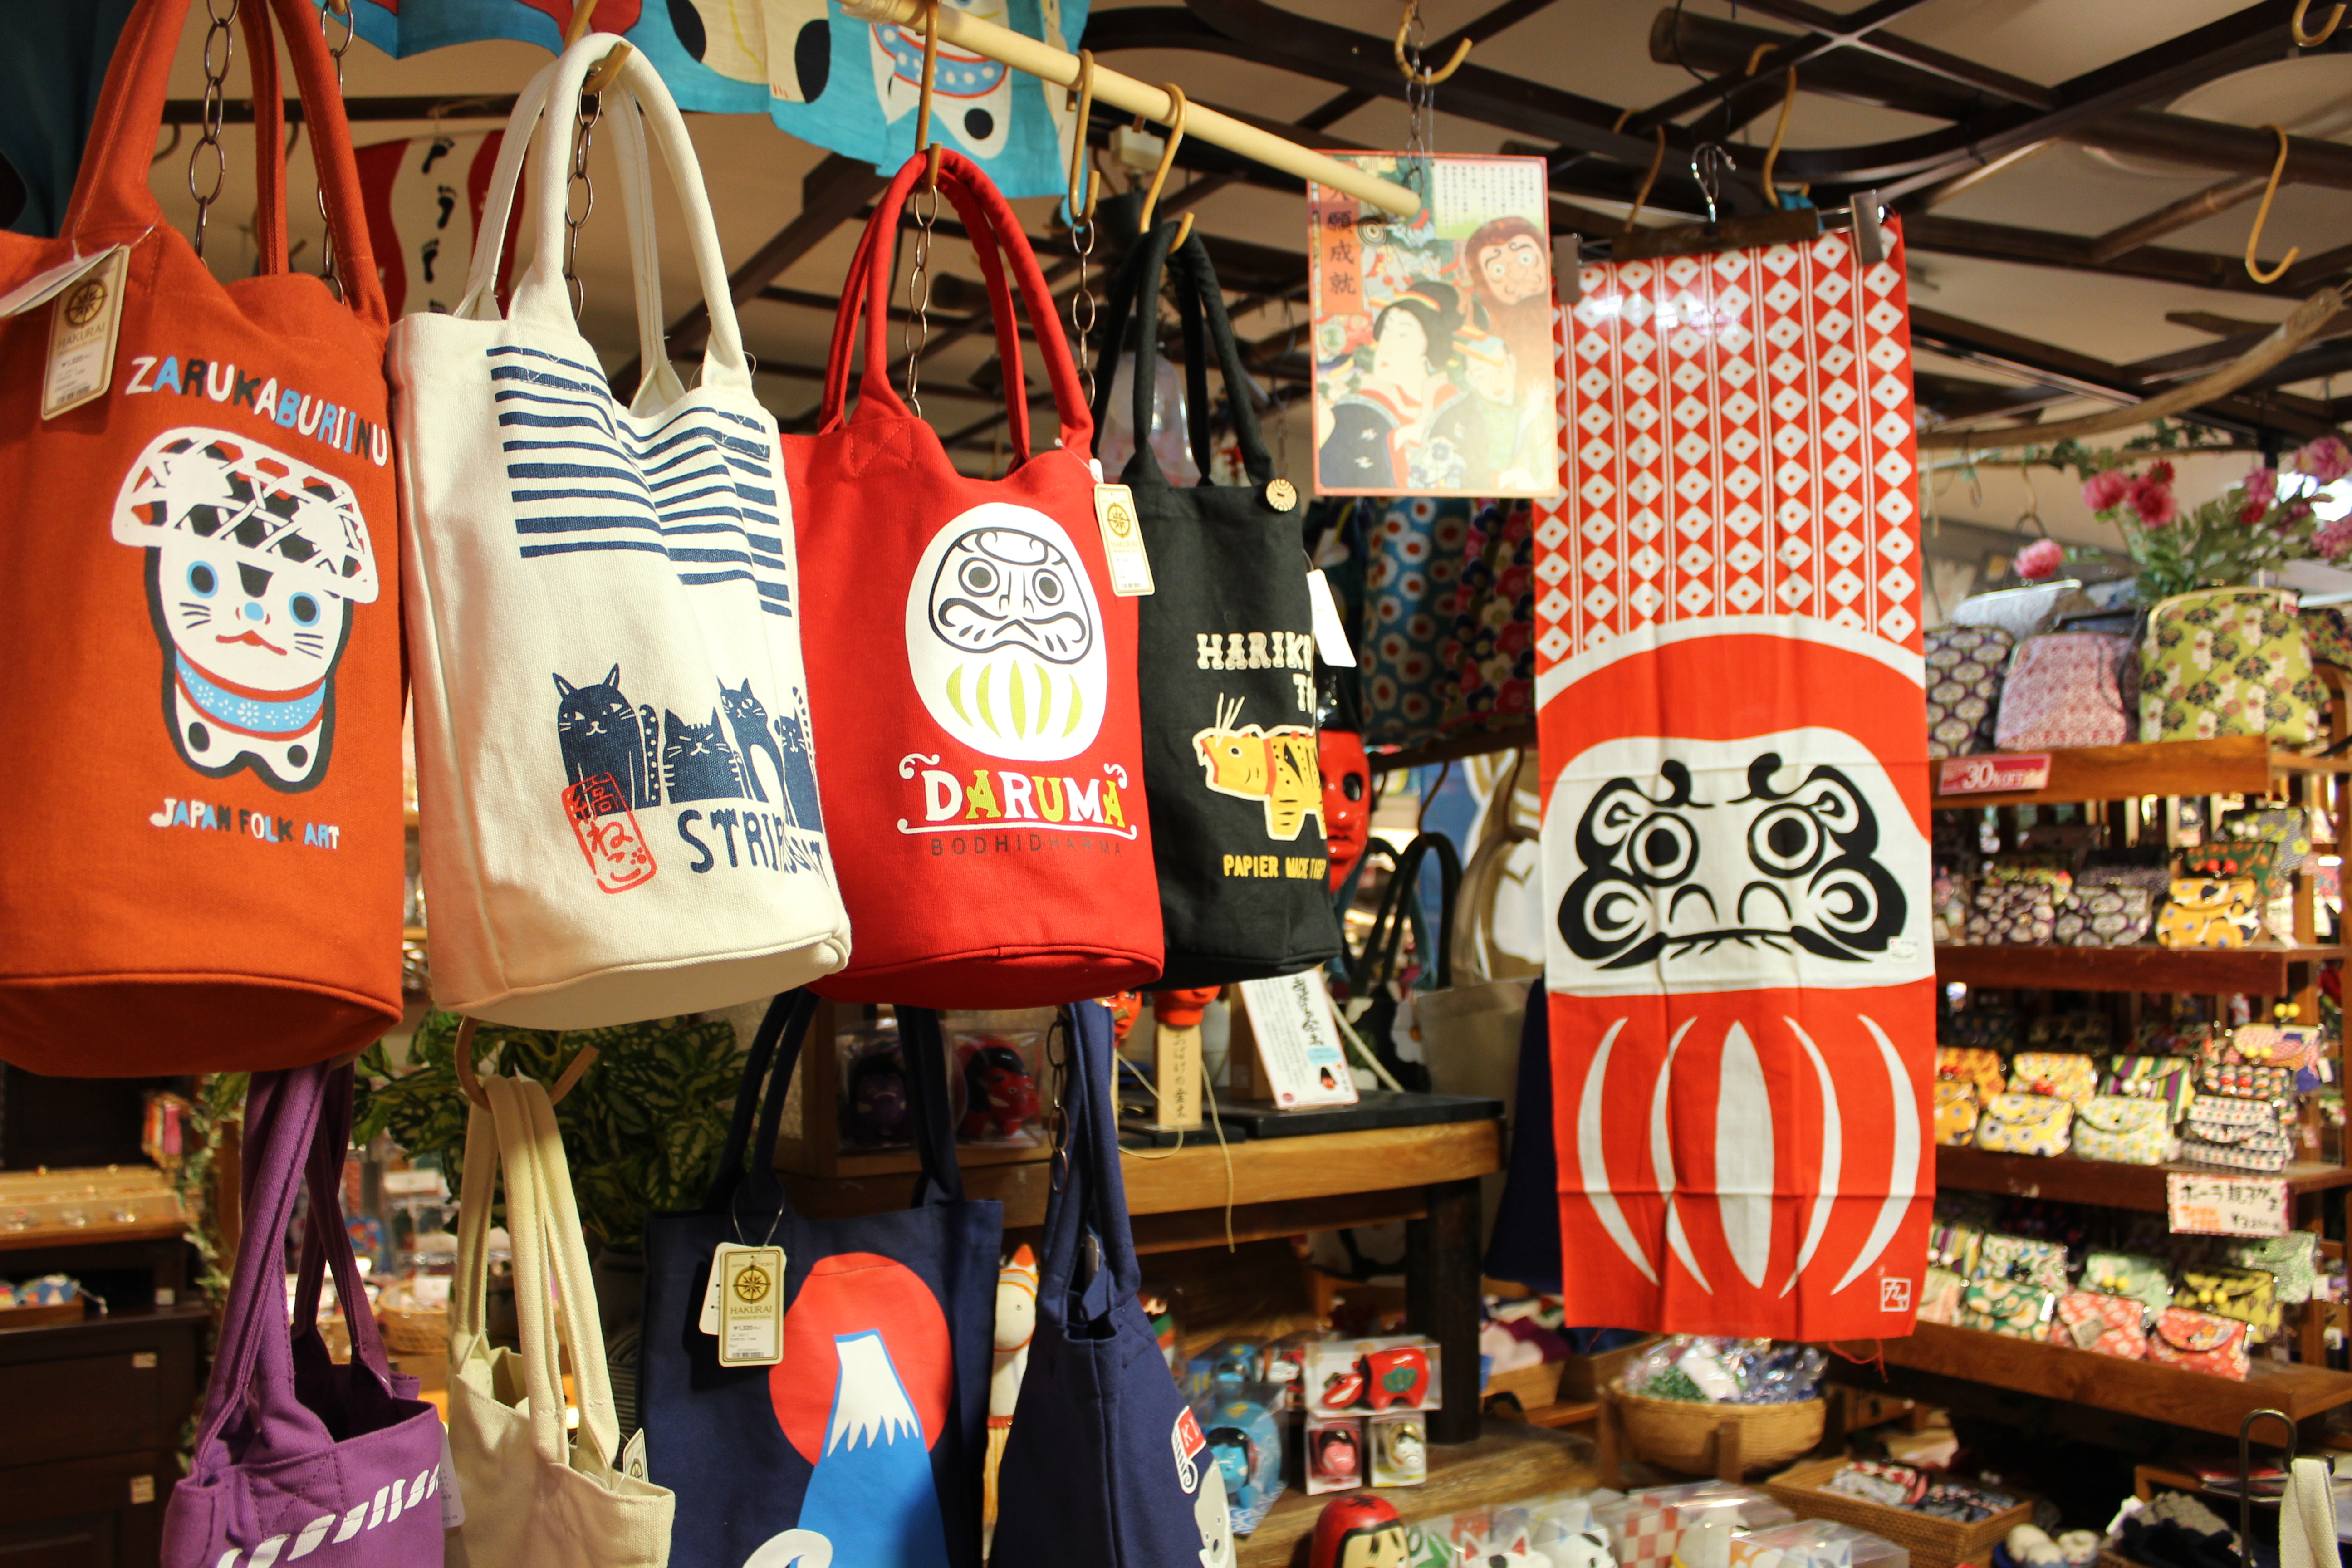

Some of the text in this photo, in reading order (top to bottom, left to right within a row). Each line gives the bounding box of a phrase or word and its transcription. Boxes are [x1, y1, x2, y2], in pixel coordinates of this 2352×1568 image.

[126, 356, 388, 466] ZARUKABURIINU
[921, 769, 1126, 828] DARUMA
[149, 798, 340, 850] JAPAN FOLK ART
[931, 833, 1123, 857] BODHIDHARMA
[1223, 854, 1279, 878] PAPIER
[730, 1305, 772, 1315] HAKURAI
